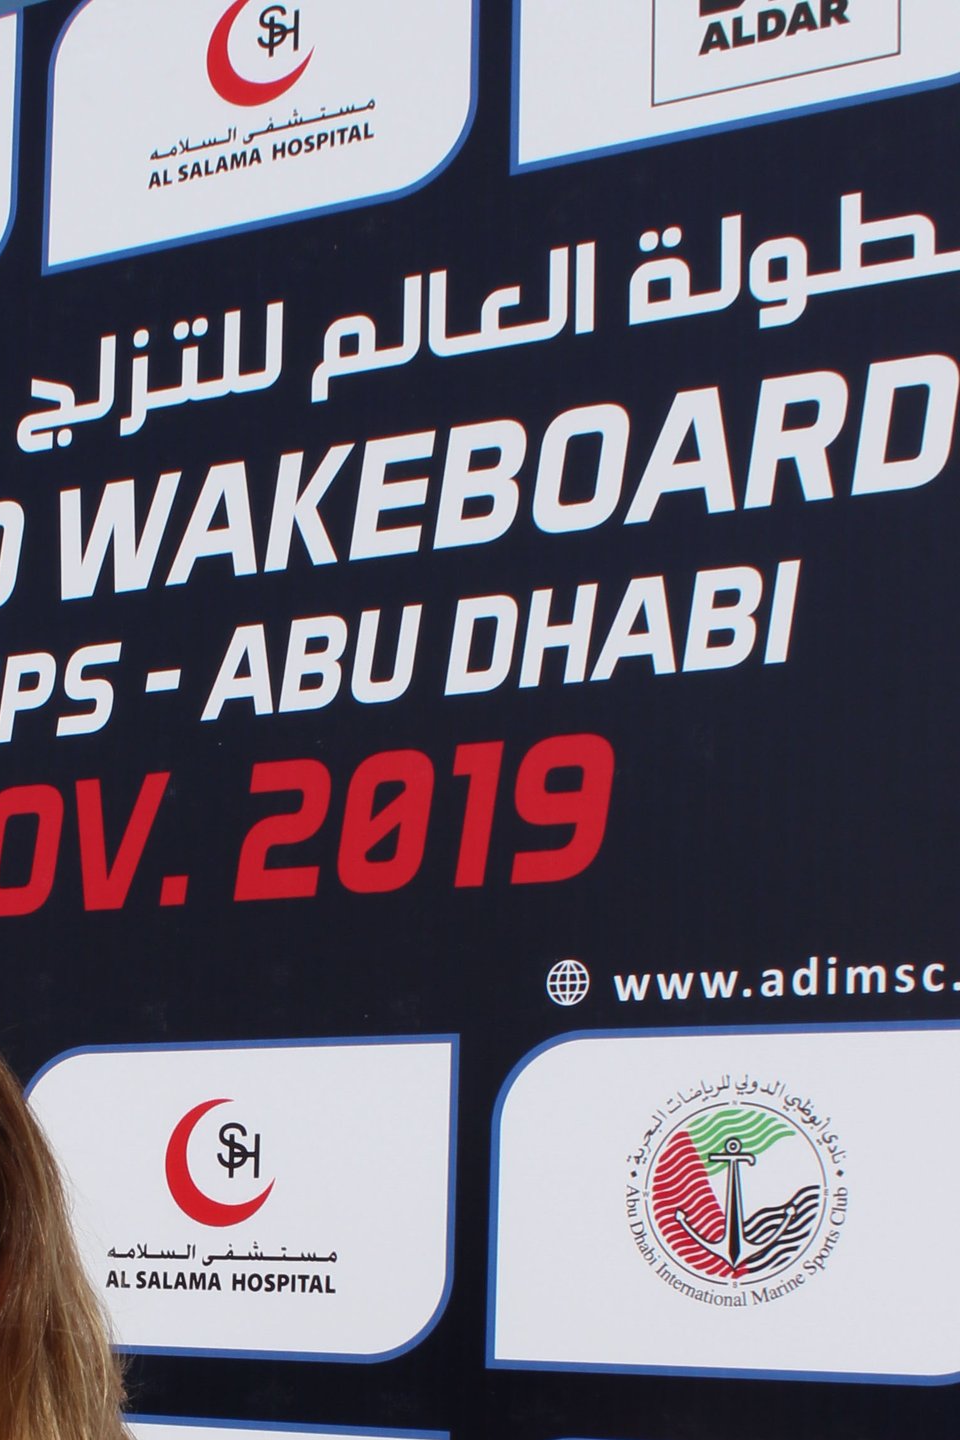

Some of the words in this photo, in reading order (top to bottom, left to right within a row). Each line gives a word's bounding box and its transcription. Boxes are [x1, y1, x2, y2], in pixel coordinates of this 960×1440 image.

[699, 0, 850, 56] ALDAR
[149, 169, 172, 189] AL
[178, 148, 261, 182] SALAMA
[272, 122, 374, 160] HOSPITAL
[311, 240, 595, 403] العالم
[17, 301, 283, 453] للتزلج
[60, 353, 960, 601] WAKEBOARD
[200, 604, 422, 721] ABU
[444, 559, 801, 696] DHABI
[234, 734, 614, 901] 2019
[626, 1185, 640, 1217] Abu
[831, 1187, 848, 1226] Club
[630, 1221, 661, 1262] Dhabi
[803, 1231, 839, 1275] Sports
[106, 1270, 130, 1288] AL
[136, 1271, 221, 1290] SALAMA
[232, 1273, 336, 1293] HOSPITAL
[655, 1262, 747, 1307] International
[751, 1272, 806, 1305] Marine
